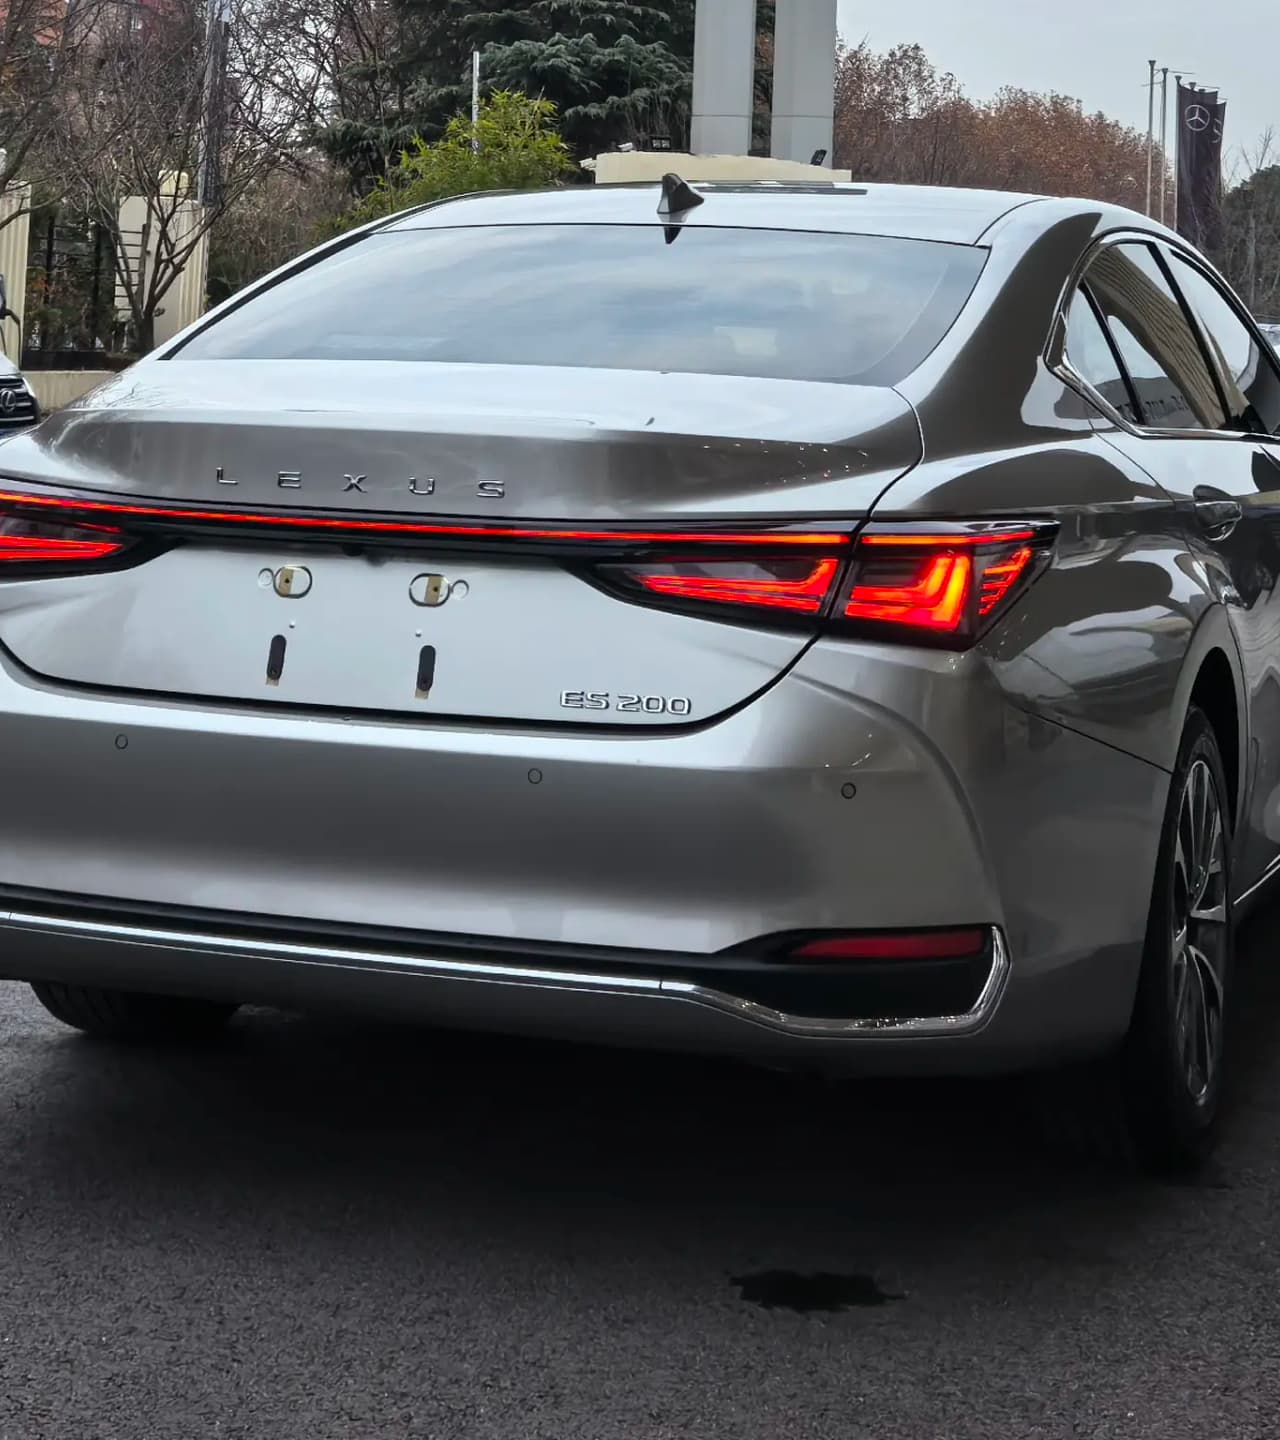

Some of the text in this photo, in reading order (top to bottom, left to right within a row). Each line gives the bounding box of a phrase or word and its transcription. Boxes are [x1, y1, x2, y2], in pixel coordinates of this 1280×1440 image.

[216, 467, 505, 498] LEXUS
[560, 690, 691, 715] ES 200
